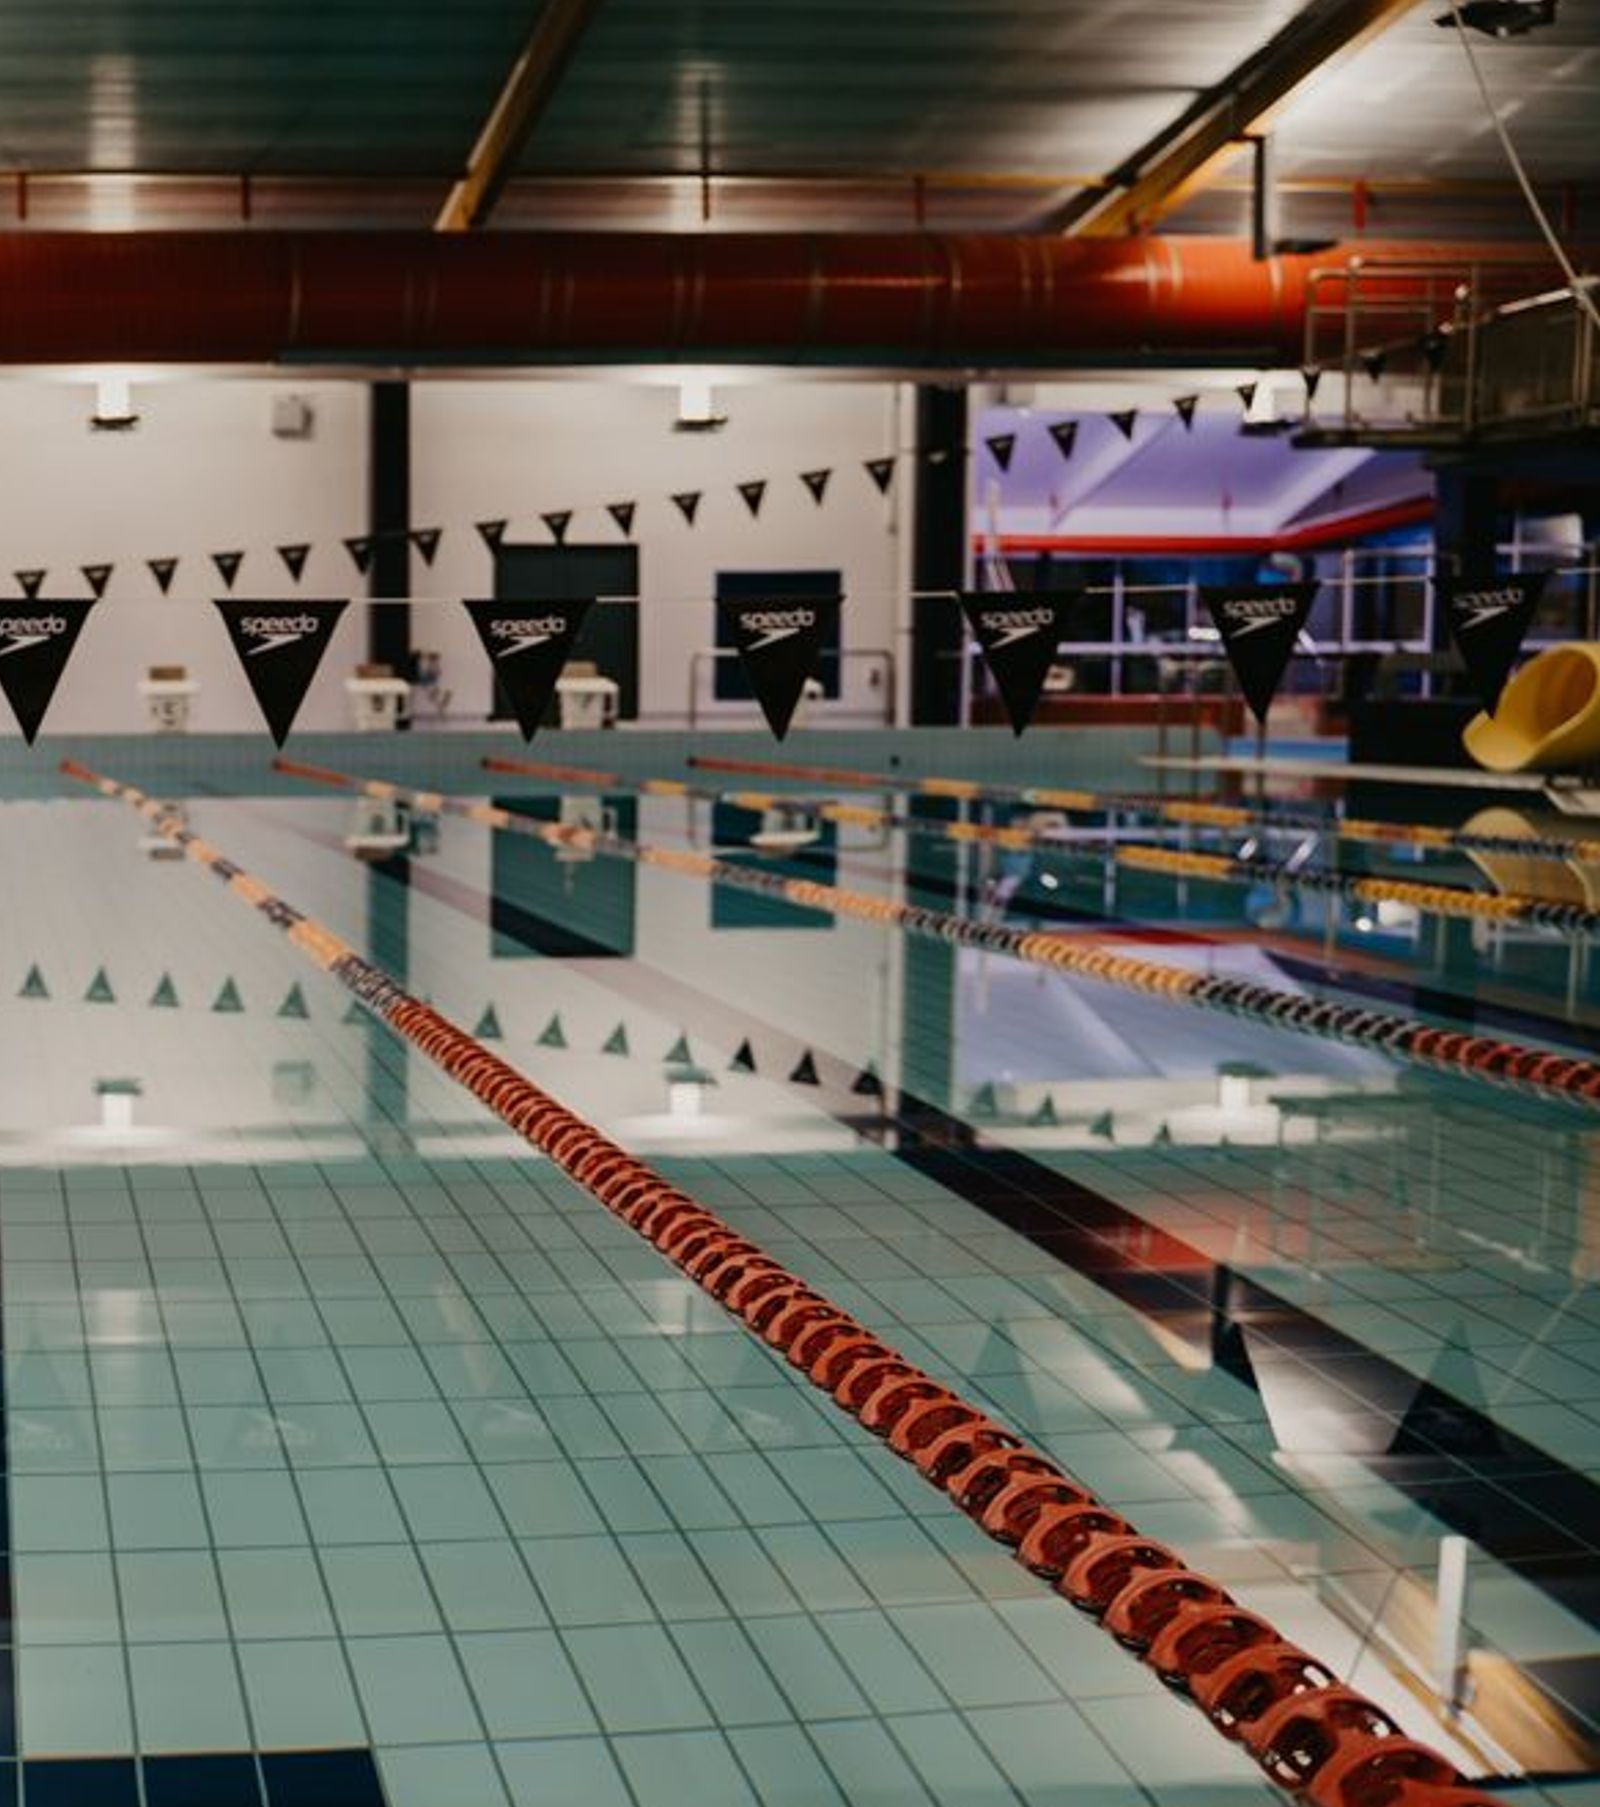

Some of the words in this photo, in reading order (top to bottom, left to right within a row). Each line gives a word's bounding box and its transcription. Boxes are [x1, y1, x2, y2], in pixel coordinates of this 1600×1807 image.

[740, 608, 815, 630] speedo
[981, 606, 1054, 629] speedo
[1223, 597, 1297, 620] speedo
[241, 613, 319, 636] speedo
[490, 615, 566, 637] speedo
